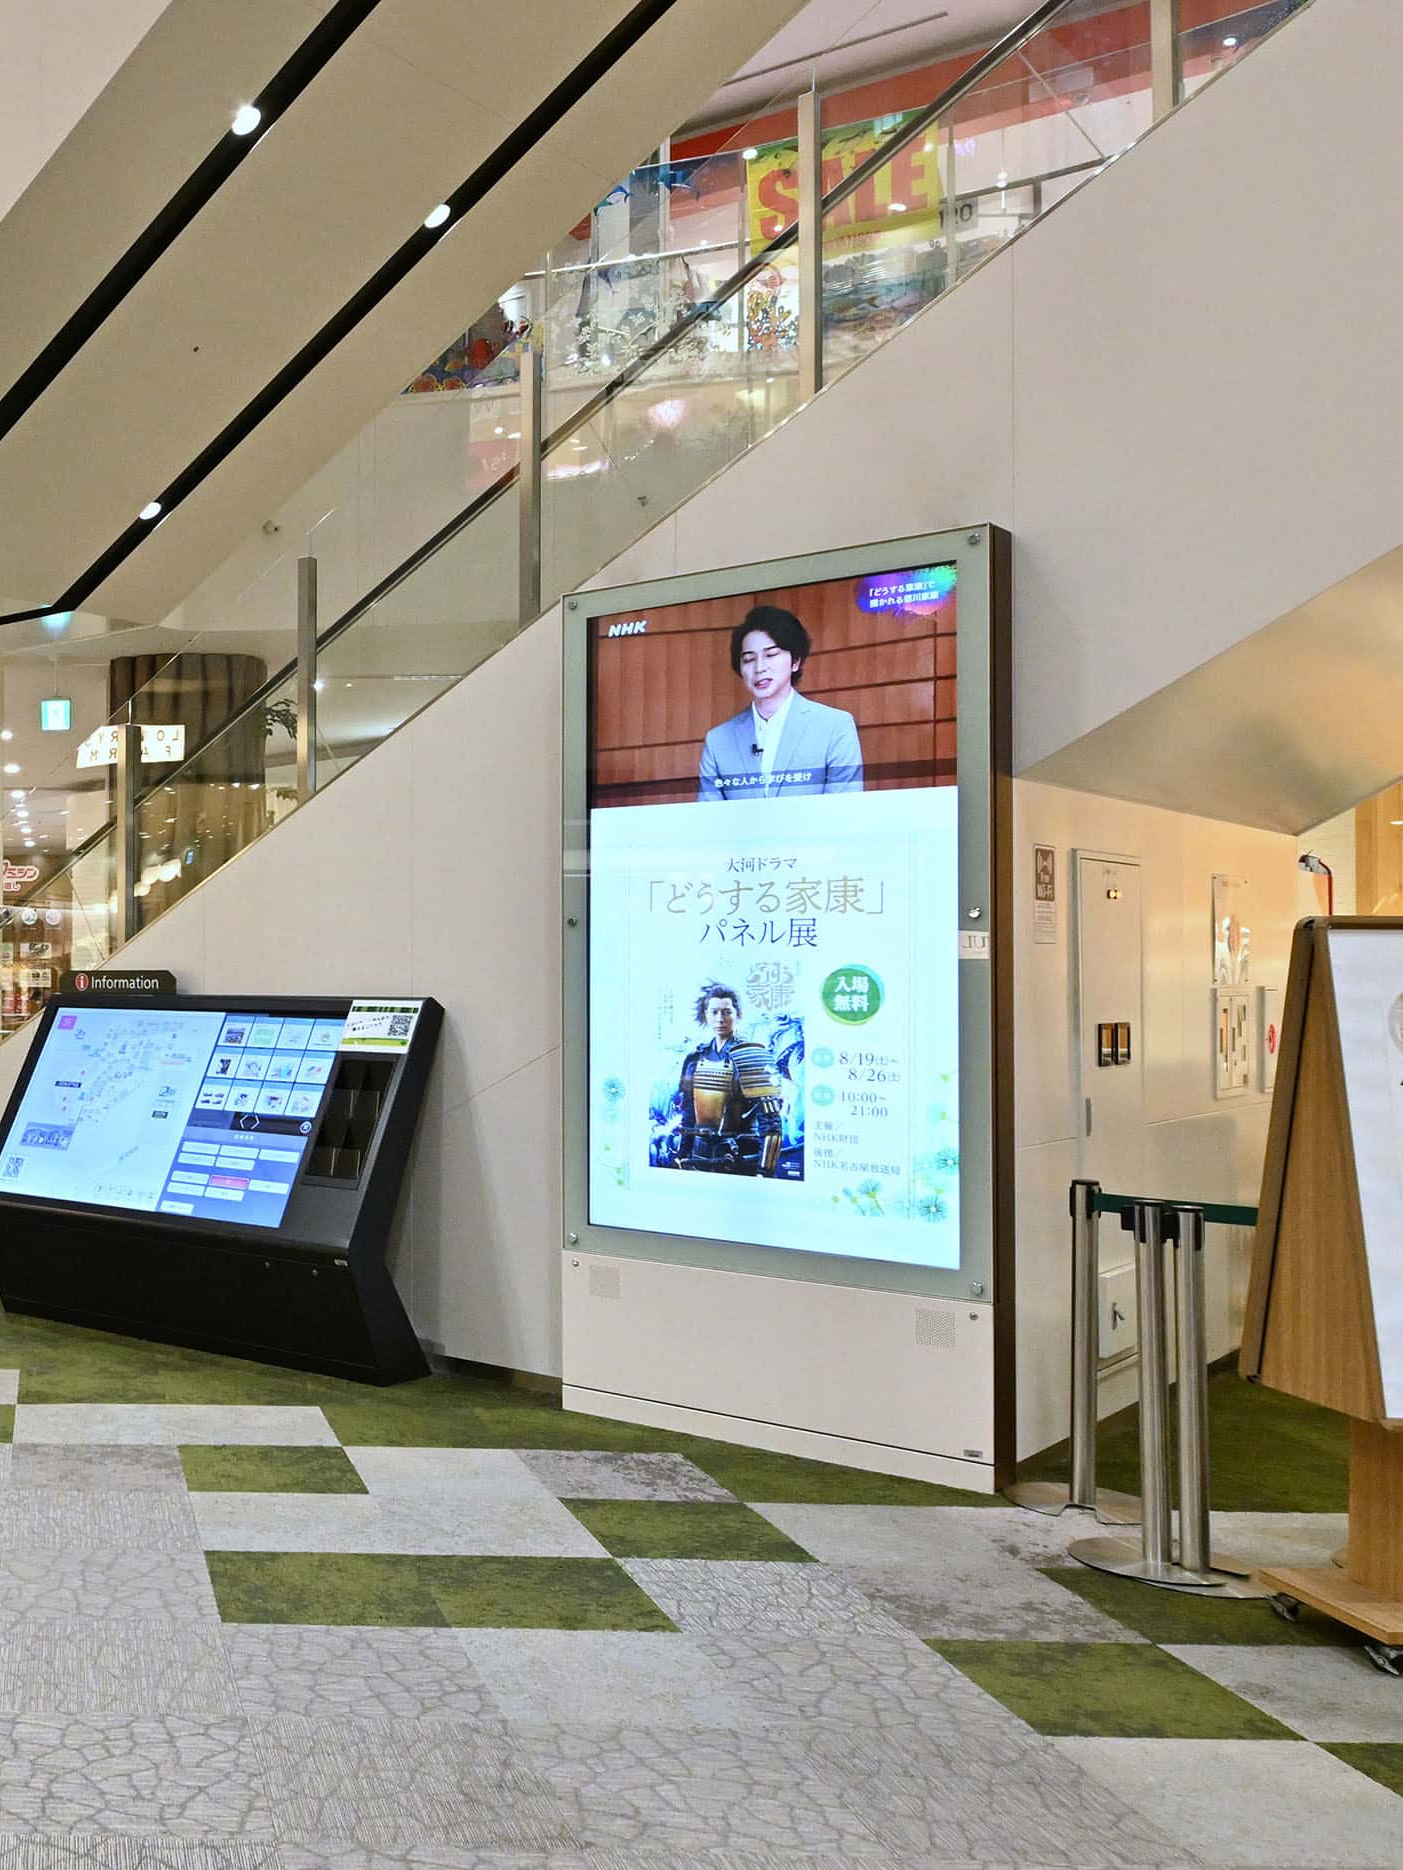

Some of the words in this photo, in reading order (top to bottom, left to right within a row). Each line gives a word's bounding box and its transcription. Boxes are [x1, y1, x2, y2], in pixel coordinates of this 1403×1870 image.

[757, 134, 929, 240] SALE
[608, 620, 646, 637] NHK
[726, 856, 798, 873] 大河ドラマ
[650, 876, 884, 916] 「どうする家康」
[699, 917, 818, 948] パネル展
[91, 975, 159, 989] Information
[834, 975, 870, 993] 入場
[833, 994, 870, 1012] 無料
[850, 1105, 889, 1117] 21:00
